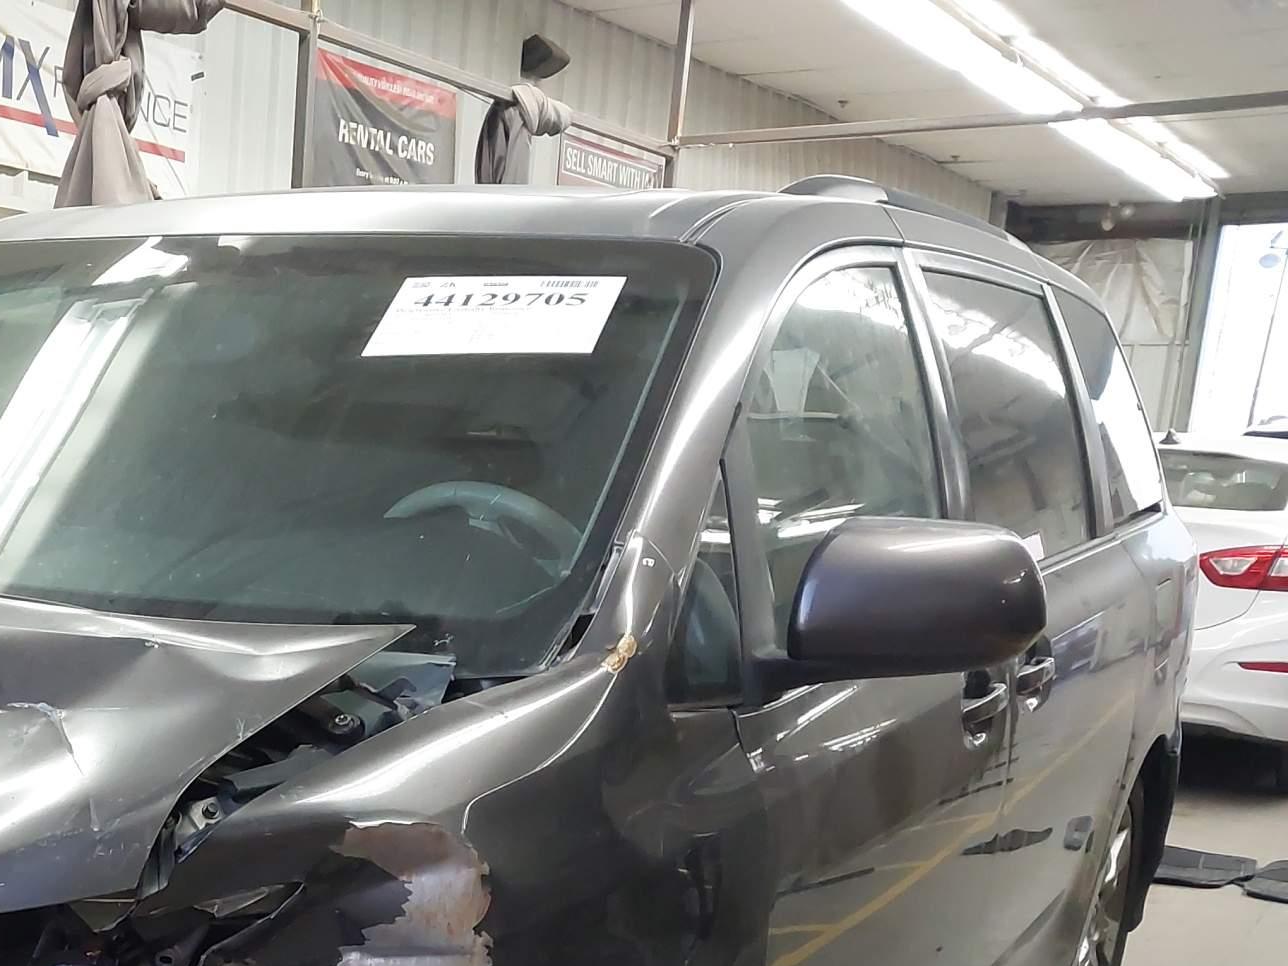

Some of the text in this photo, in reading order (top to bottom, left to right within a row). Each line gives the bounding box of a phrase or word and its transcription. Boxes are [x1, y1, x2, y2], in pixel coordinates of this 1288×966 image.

[338, 118, 435, 166] RENTAL CARS
[565, 147, 586, 173] SELL
[587, 154, 619, 184] SMART
[619, 163, 641, 189] WITH
[414, 292, 589, 307] 44129705
